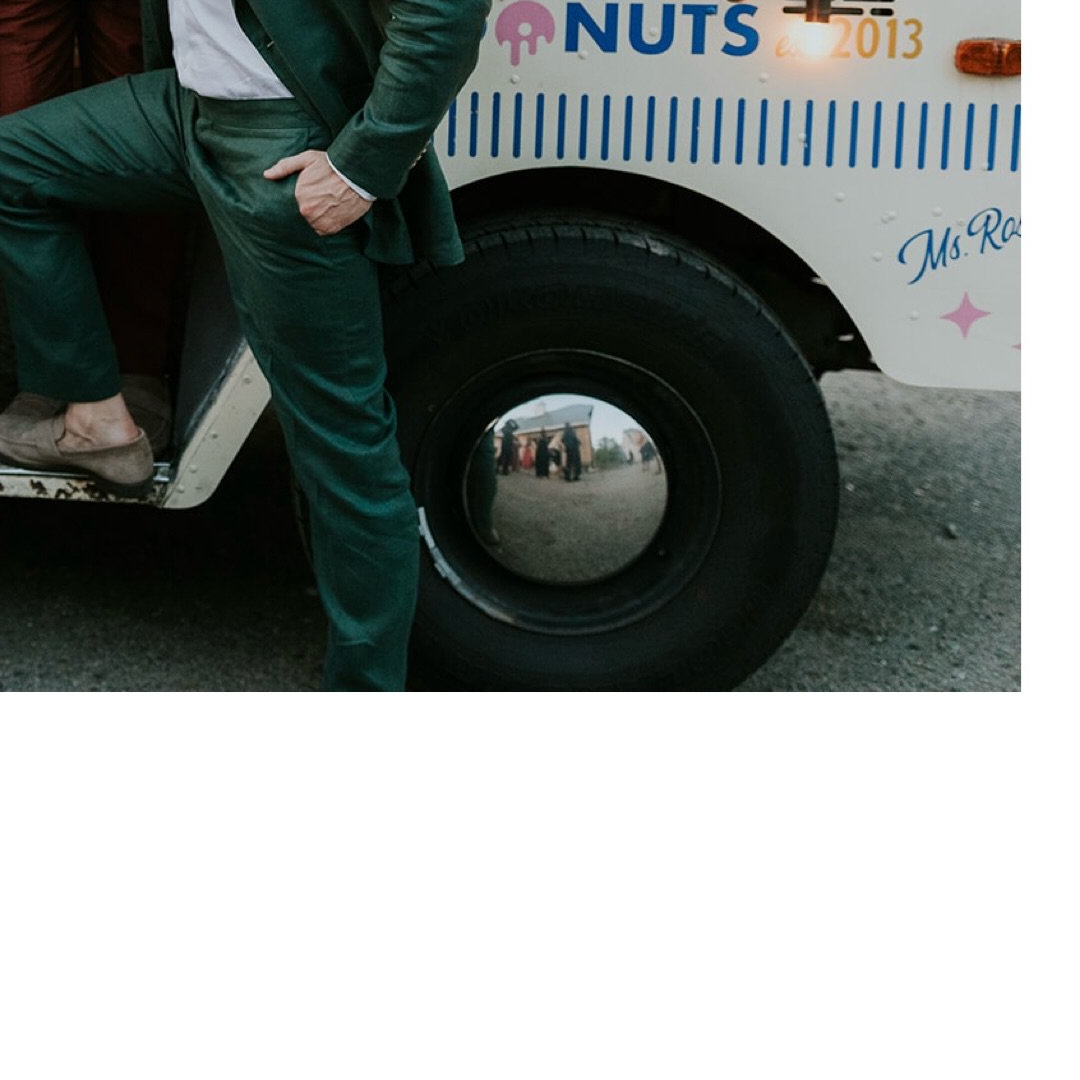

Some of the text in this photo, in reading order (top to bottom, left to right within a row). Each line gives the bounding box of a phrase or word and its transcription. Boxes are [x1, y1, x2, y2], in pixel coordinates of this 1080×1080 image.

[564, 2, 760, 57] NUTS
[829, 17, 924, 59] 2013
[898, 206, 1021, 286] Ms. Ro
